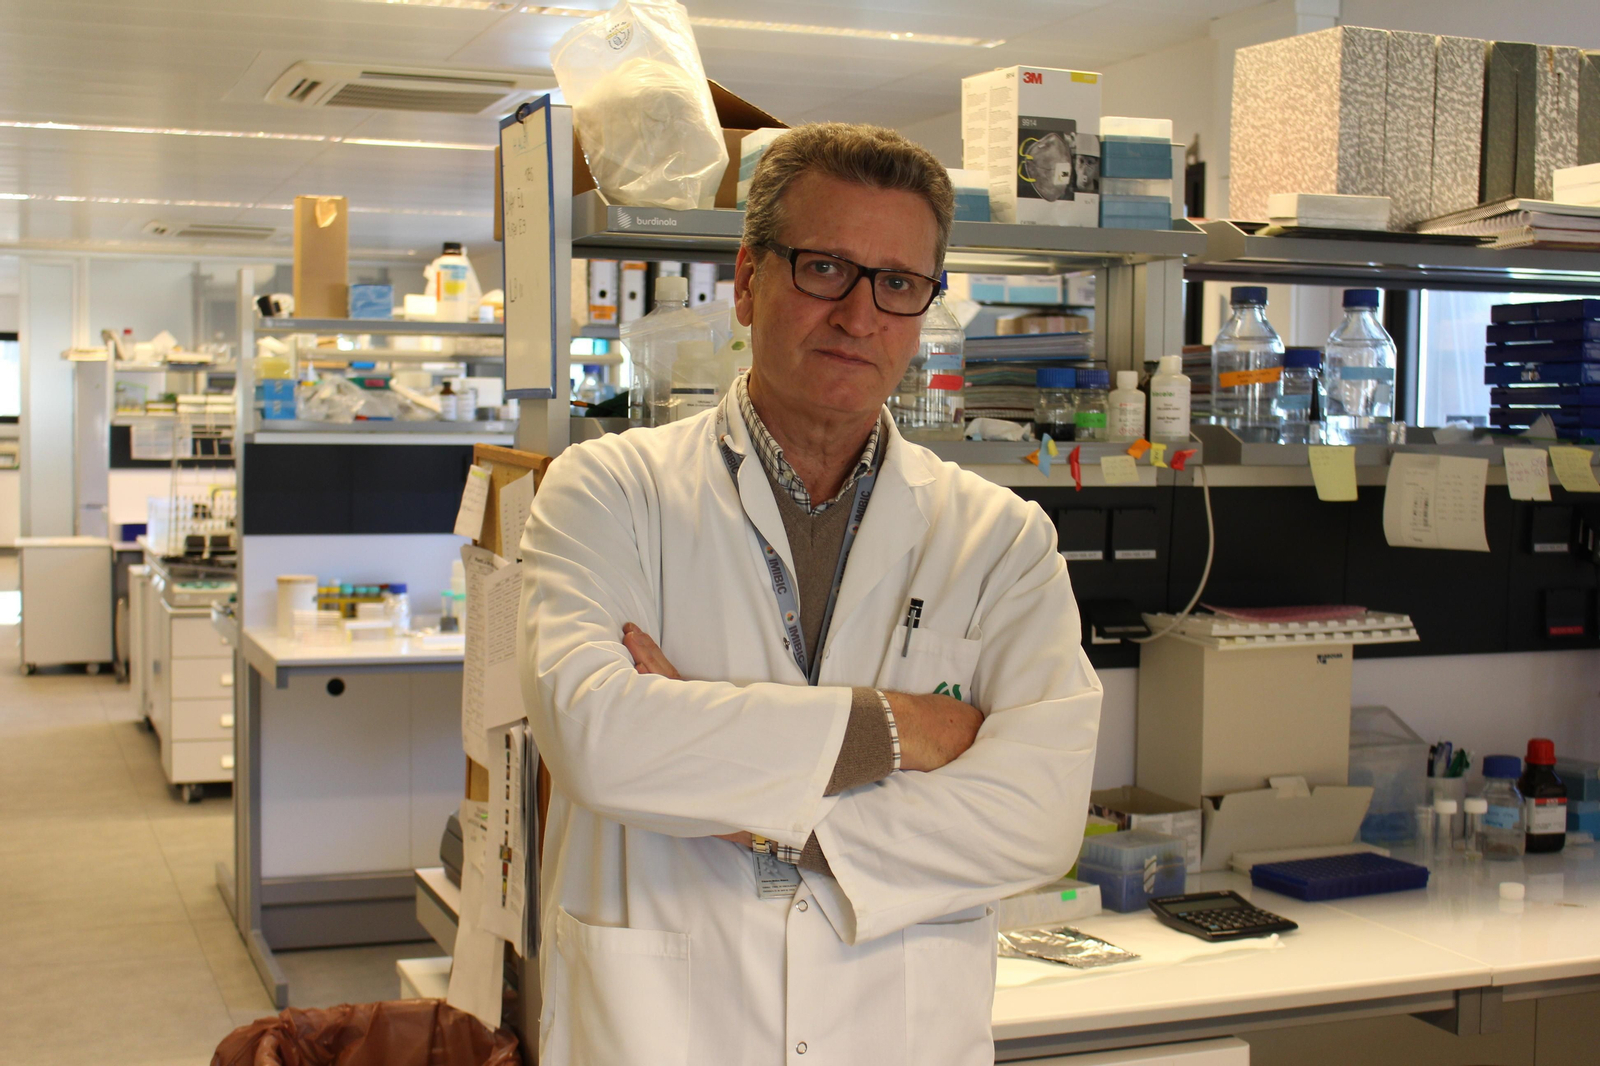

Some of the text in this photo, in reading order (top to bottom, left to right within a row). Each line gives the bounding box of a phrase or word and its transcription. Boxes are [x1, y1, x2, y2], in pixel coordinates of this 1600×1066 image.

[1023, 72, 1043, 84] 3M
[636, 217, 677, 226] burdinola
[721, 444, 739, 474] IMIBIC
[768, 558, 788, 595] IMIBIC
[788, 625, 805, 664] IMIBIC
